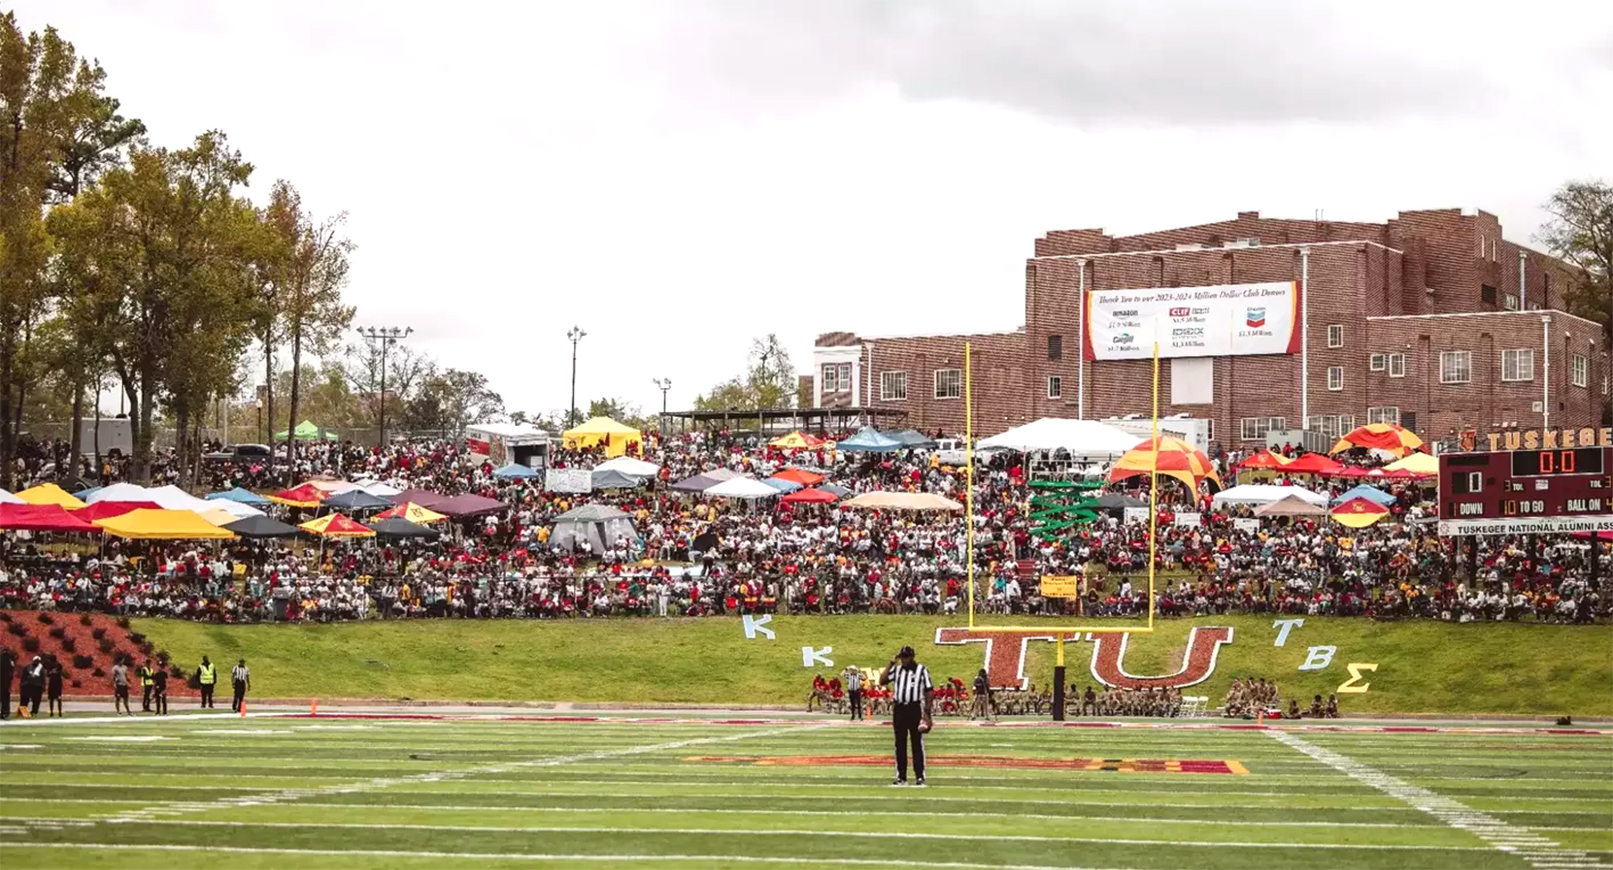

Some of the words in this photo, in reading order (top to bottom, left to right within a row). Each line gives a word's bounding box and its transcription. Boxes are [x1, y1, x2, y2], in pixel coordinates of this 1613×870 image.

[1099, 295, 1119, 304] Thank
[1261, 288, 1286, 297] Donors
[1112, 309, 1139, 317] amazon
[1460, 502, 1483, 515] DOWN
[1520, 501, 1530, 513] TO
[1532, 500, 1544, 512] GO
[1567, 499, 1587, 512] BALL
[1589, 498, 1601, 510] ON
[1457, 525, 1506, 534] TUSKEGEE
[1508, 523, 1555, 533] NATIONAL
[1558, 522, 1594, 532] ALUMNI
[935, 626, 1233, 692] TU
